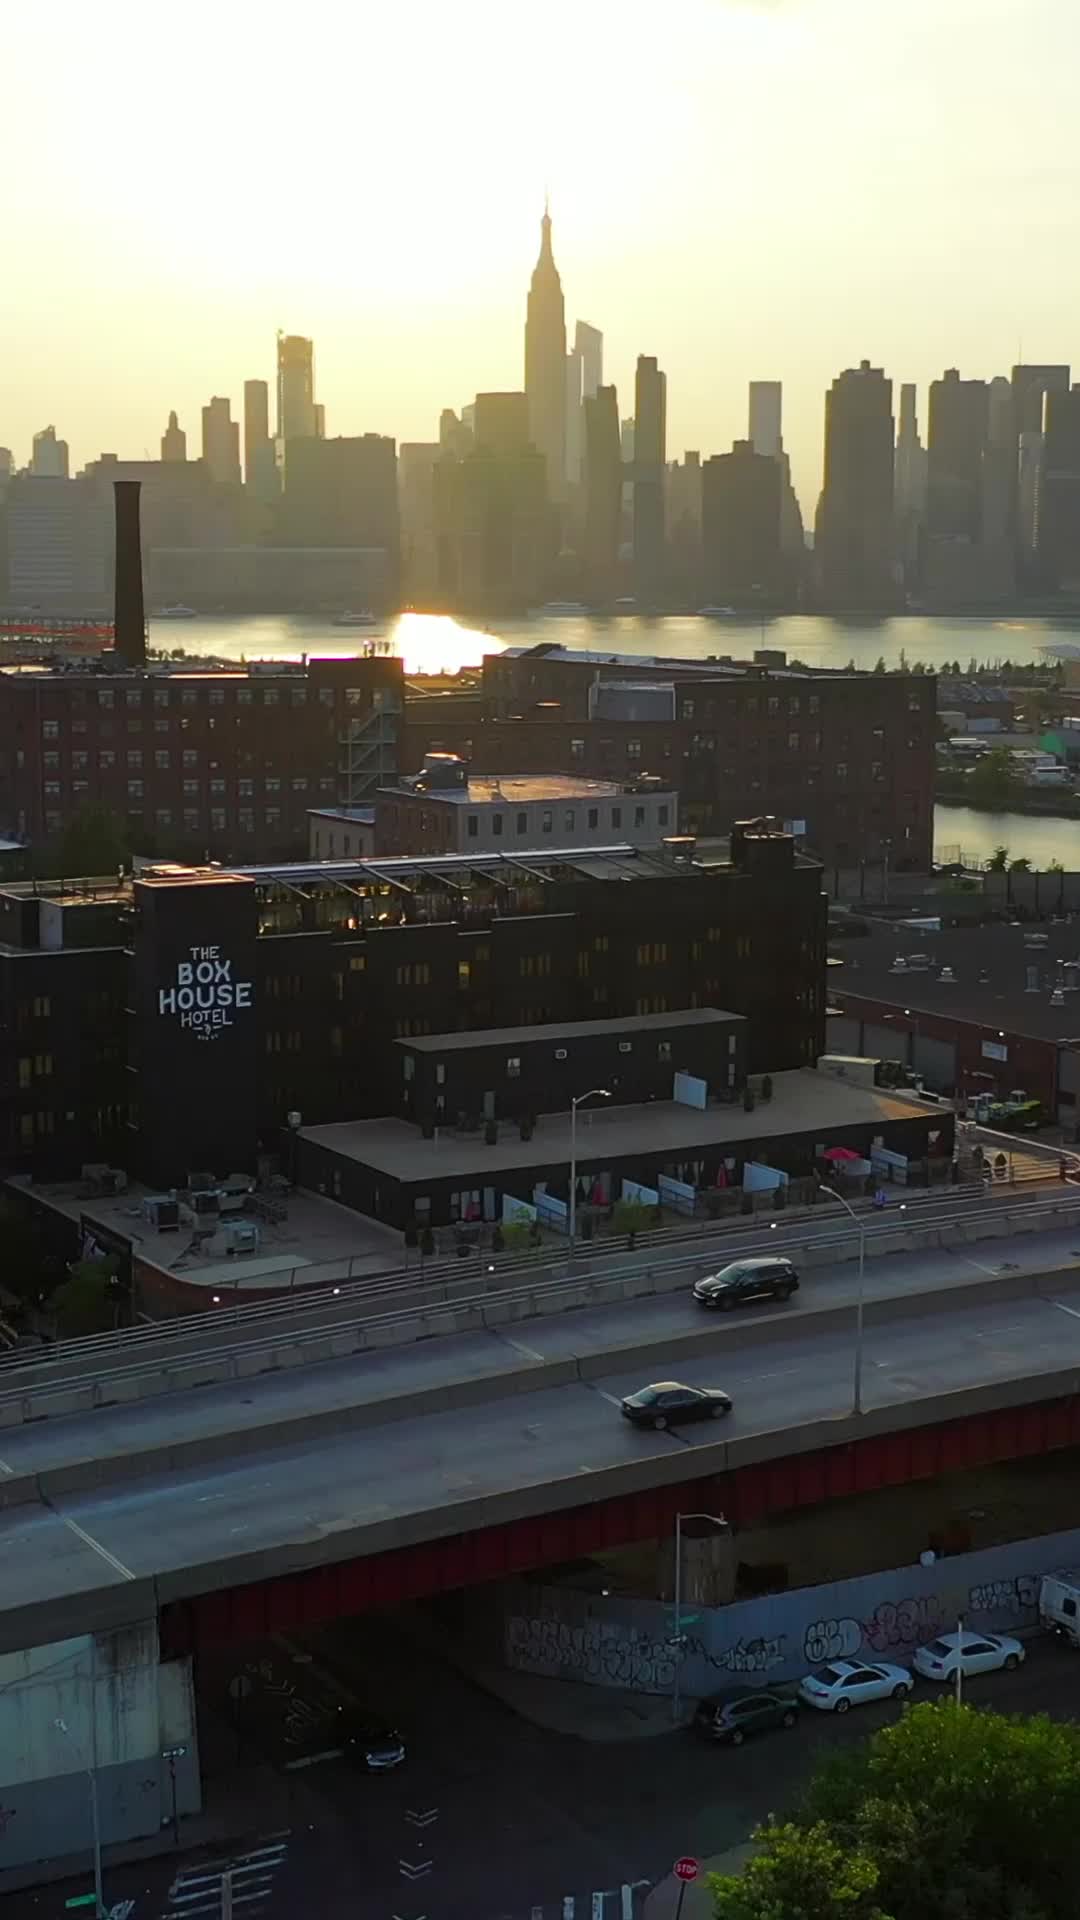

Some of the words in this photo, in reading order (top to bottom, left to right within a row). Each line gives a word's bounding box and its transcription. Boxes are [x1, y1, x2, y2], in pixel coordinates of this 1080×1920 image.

[190, 946, 220, 960] THE
[178, 960, 231, 985] BOX
[159, 982, 252, 1014] HOUSE
[181, 1009, 233, 1027] HOTEL
[677, 1863, 697, 1874] STOP
